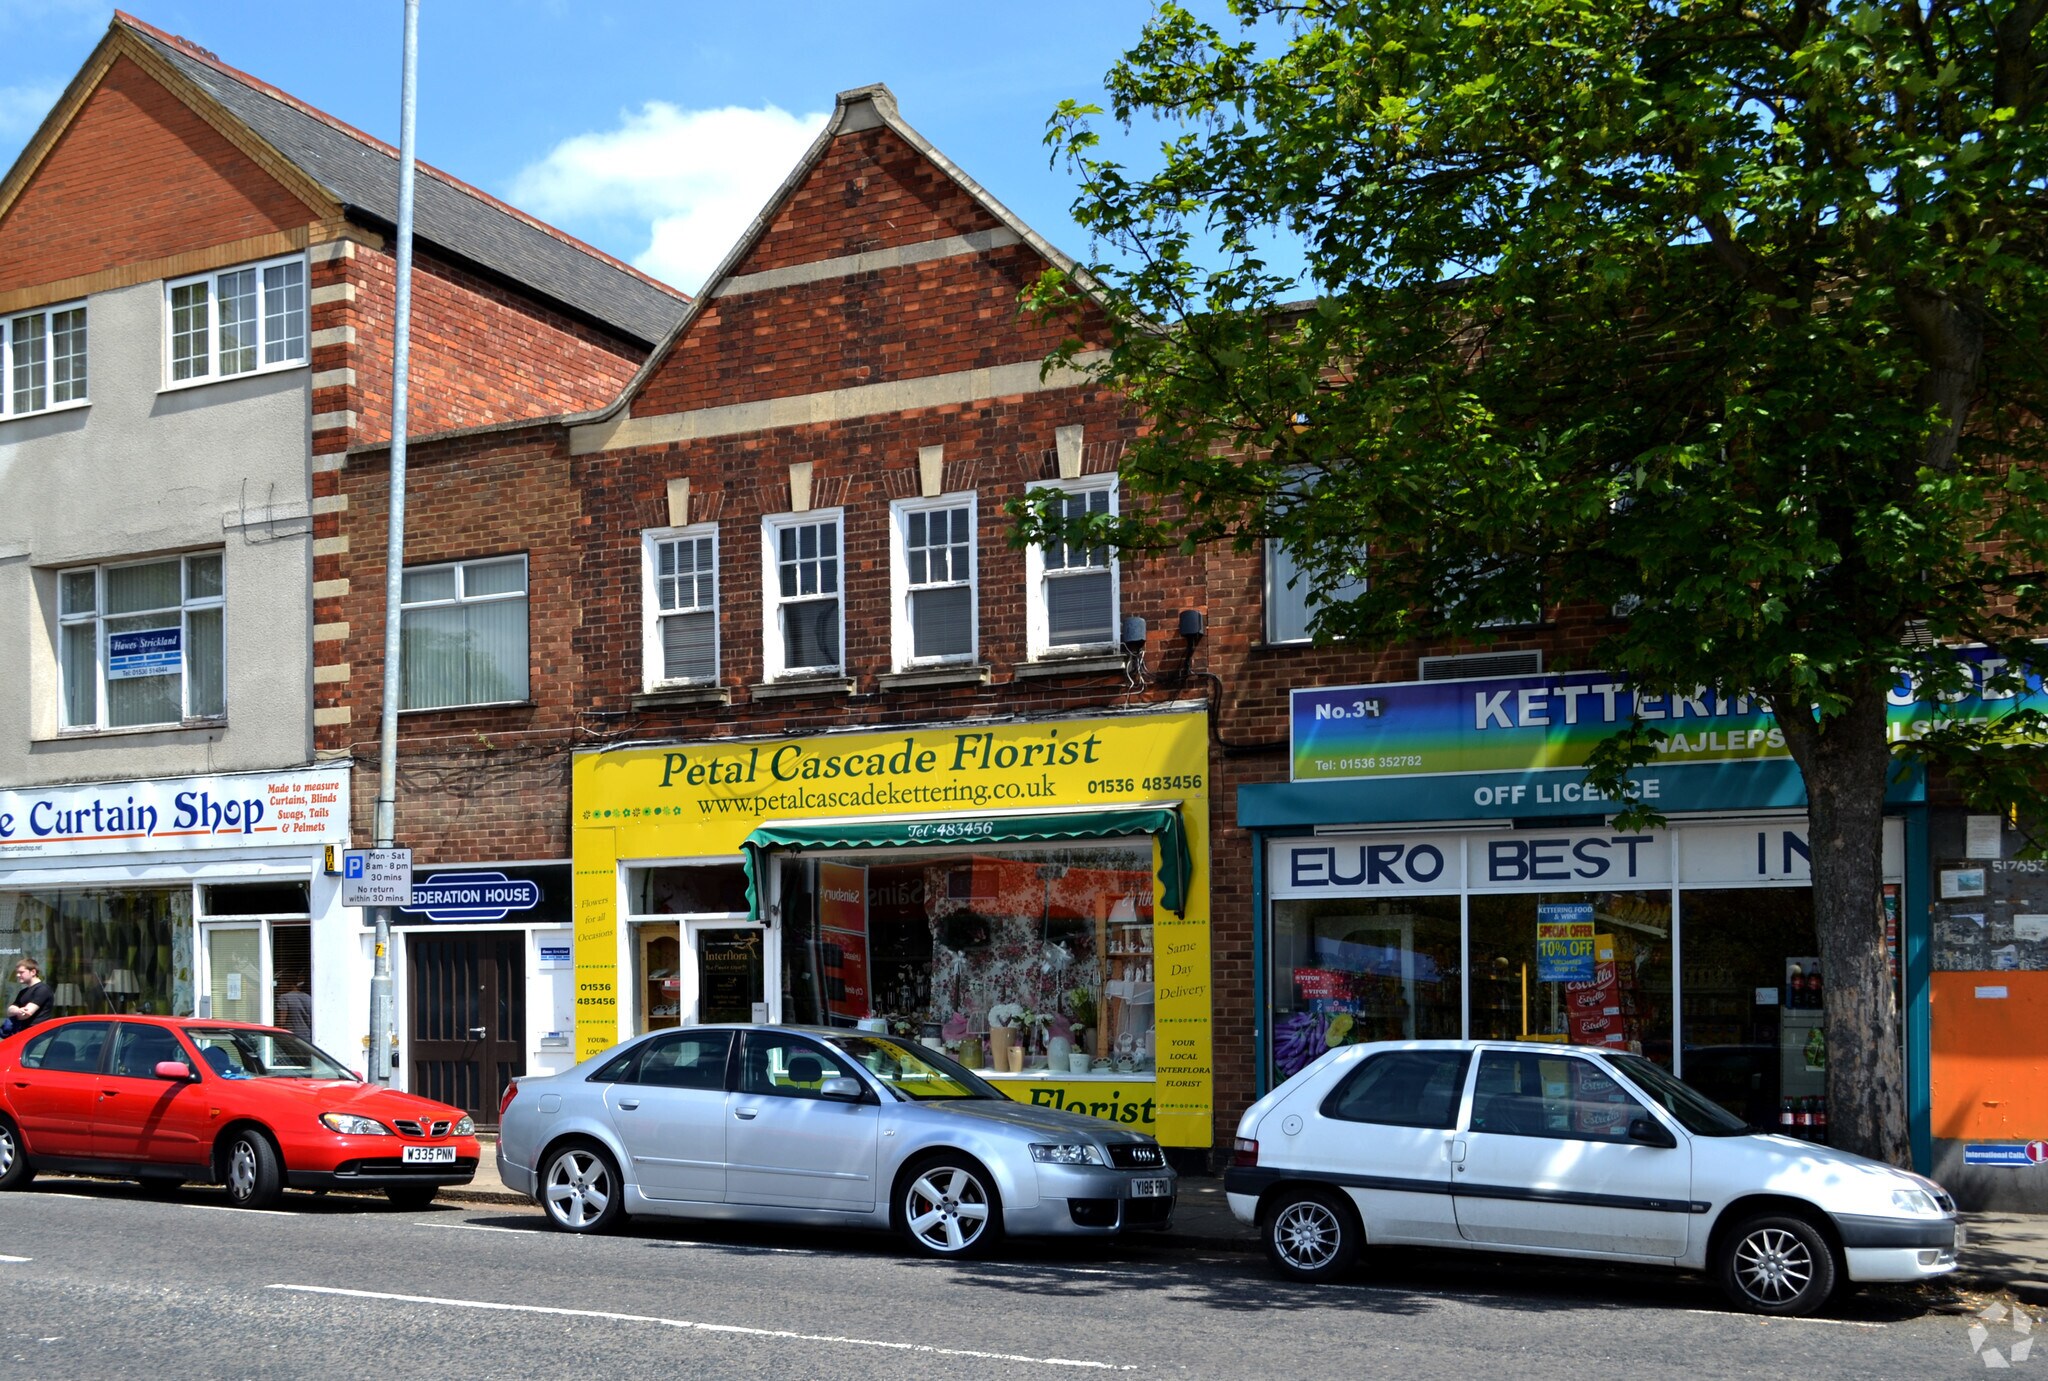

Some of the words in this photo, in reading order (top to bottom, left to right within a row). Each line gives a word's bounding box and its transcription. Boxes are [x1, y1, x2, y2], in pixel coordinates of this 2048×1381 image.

[114, 641, 137, 651] Hawes
[140, 635, 177, 648] Strickland
[1315, 700, 1380, 720] No.34
[658, 748, 759, 787] Petal
[771, 738, 936, 781] Cascade
[949, 729, 1102, 771] Florist
[1315, 759, 1336, 771] Tel:
[1340, 758, 1375, 769] 01536
[1379, 755, 1422, 768] 352782
[268, 783, 289, 794] Made
[292, 783, 301, 792] to
[304, 782, 339, 791] measure
[1088, 778, 1135, 794] 01536
[1141, 774, 1202, 791] 483456
[270, 795, 307, 806] Curtains,
[311, 793, 337, 804] Blinds
[697, 773, 1056, 816] www.petalcascadekettering.co.uk
[1474, 785, 1527, 806] OFF
[30, 796, 158, 838] Curtain
[173, 791, 264, 835] Shop
[277, 809, 306, 820] Swags,
[309, 807, 329, 818] Tails
[281, 823, 290, 833] &
[293, 822, 325, 832] Pelmets
[369, 852, 385, 860] Mon
[391, 852, 405, 860] Sat
[1291, 844, 1444, 887] EURO
[1489, 835, 1653, 882] BEST
[372, 894, 384, 902] 30
[412, 889, 480, 905] EDERATION
[485, 888, 530, 902] HOUSE
[581, 897, 609, 908] Flowers
[1539, 906, 1572, 914] KETTERING
[585, 915, 596, 925] for
[597, 912, 606, 921] all
[577, 930, 614, 942] Occasions
[1539, 924, 1569, 938] SPECIAL
[1570, 924, 1593, 938] OFFER
[1166, 941, 1197, 955] Same
[1540, 941, 1567, 957] 10%
[1569, 941, 1593, 956] OFF
[705, 949, 747, 961] Interflora
[1171, 963, 1194, 977] Day
[580, 983, 611, 991] 01536
[1159, 984, 1207, 1000] Delivery
[577, 997, 616, 1005] 483456
[1578, 990, 1605, 1004] Estrella
[1582, 1018, 1608, 1031] Estrella
[1171, 1039, 1195, 1047] YOUR
[1157, 1066, 1211, 1074] INTERFLORA
[1166, 1080, 1202, 1088] FLORIST
[407, 1148, 434, 1160] W335
[436, 1148, 454, 1160] PNN
[1965, 1151, 2008, 1159] International
[2008, 1151, 2026, 1159] Calls
[1155, 1180, 1168, 1194] FPU
